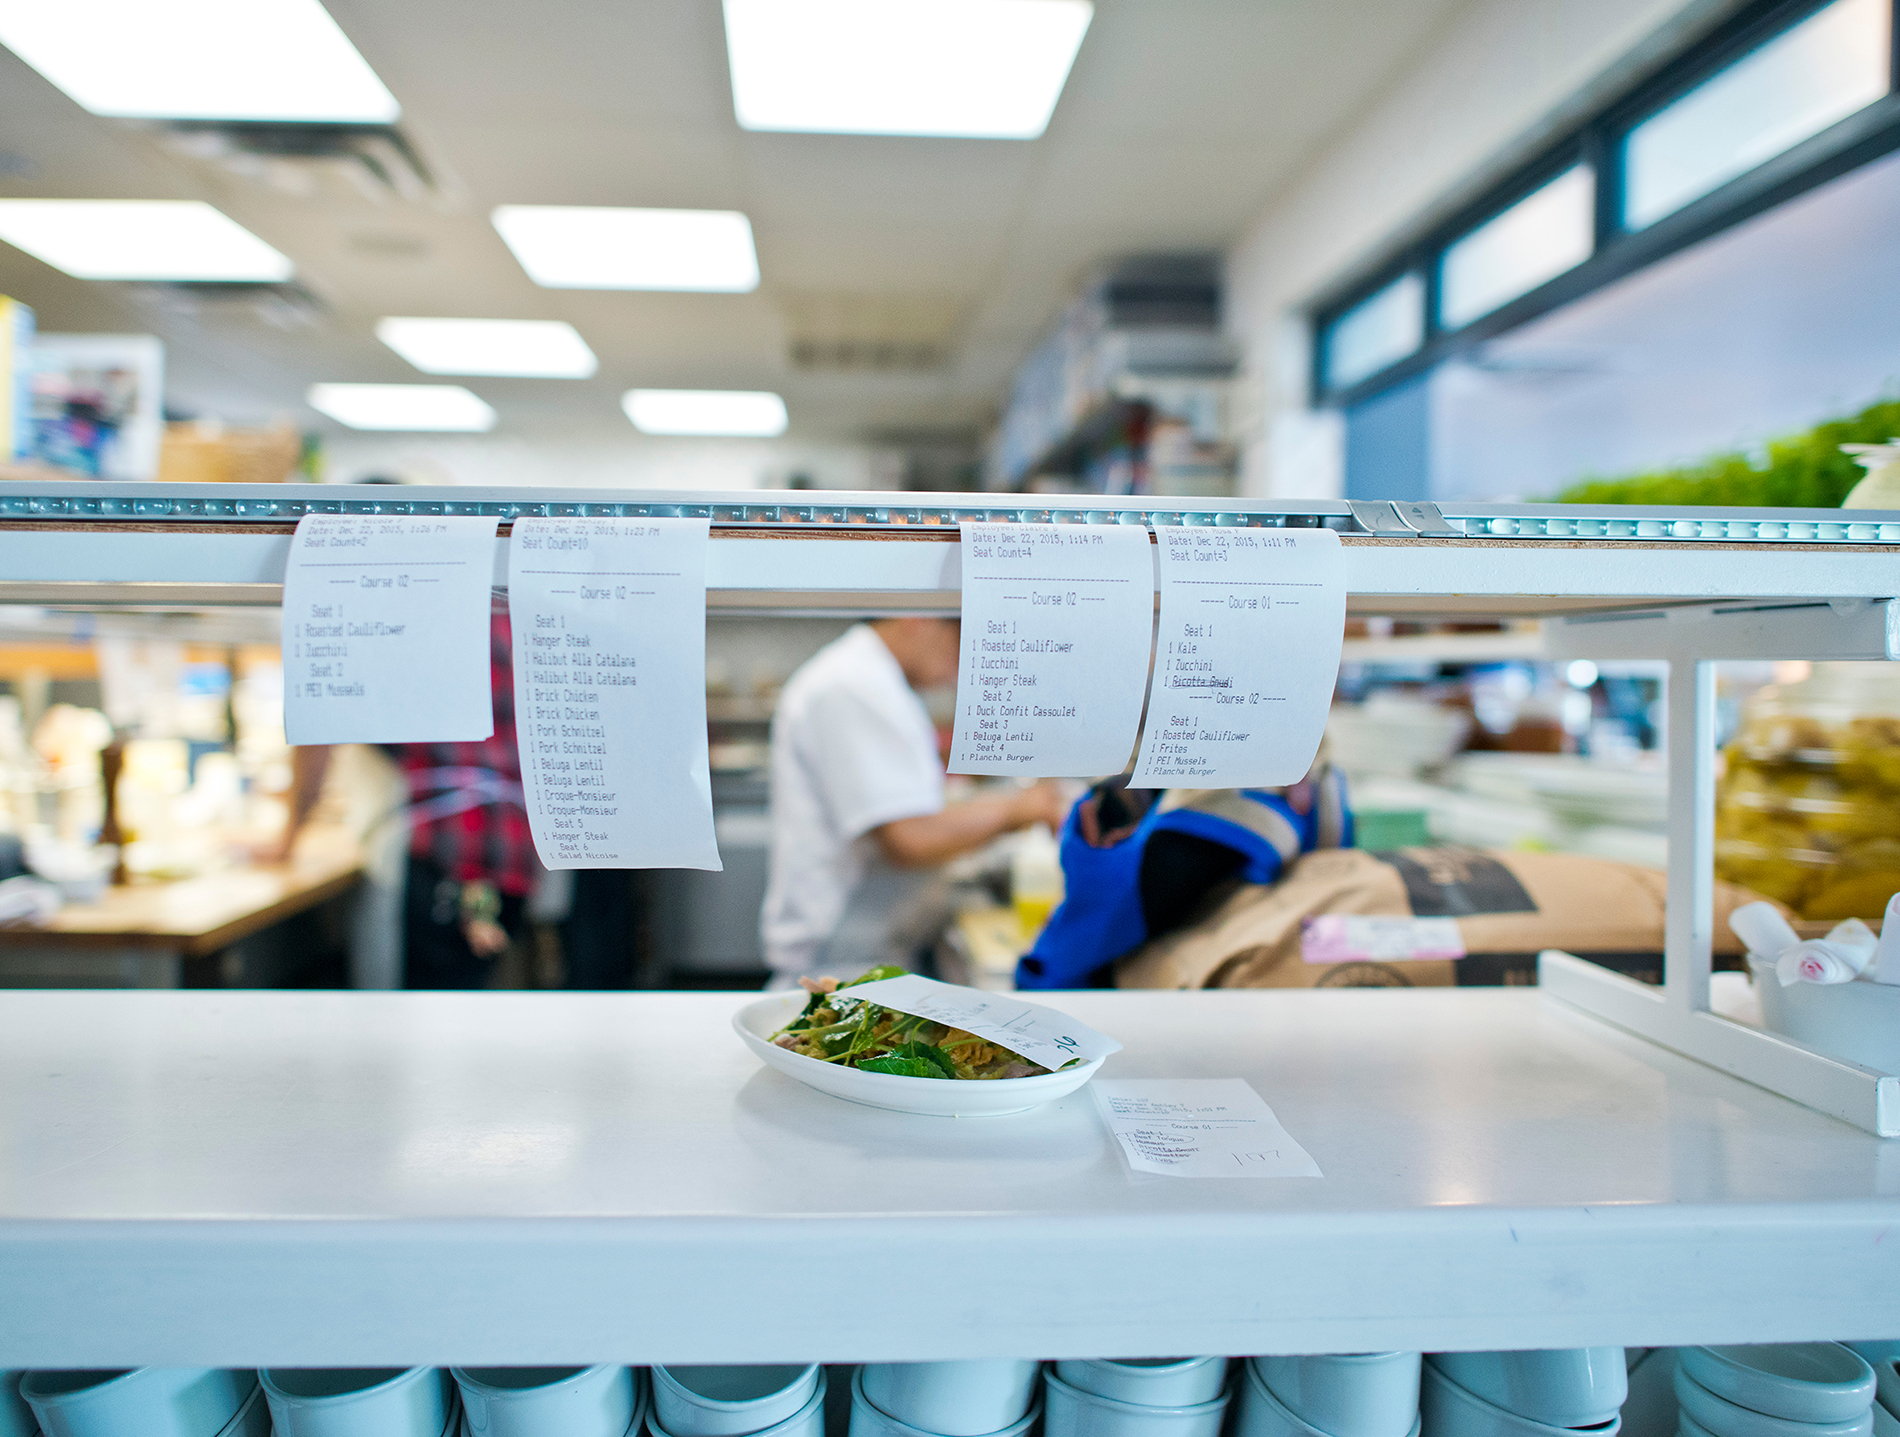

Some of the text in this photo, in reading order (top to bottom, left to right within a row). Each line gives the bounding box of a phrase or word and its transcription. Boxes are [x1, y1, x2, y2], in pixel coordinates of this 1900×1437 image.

[308, 526, 333, 535] Date:
[339, 526, 354, 534] Dec
[359, 526, 374, 534] 22,
[380, 525, 404, 534] 2015,
[435, 525, 447, 533] PM
[524, 525, 549, 534] Date:
[554, 525, 569, 534] Dec
[575, 526, 589, 535] 22,
[595, 527, 619, 537] 2015,
[649, 527, 660, 536] PM
[304, 537, 367, 547] Seat Count=2
[522, 537, 588, 550] Seat Count=10
[973, 533, 1103, 546] Date: Dec 22, 2015, 1:14 PM
[1169, 536, 1296, 549] Date: Dec 22, 2015, 1:11 PM
[973, 547, 1032, 558] Seat Count=4
[1171, 550, 1228, 562] Seat Count=3
[360, 575, 409, 588] Course 02
[580, 585, 626, 599] Course 02
[1032, 591, 1077, 606] Course 02
[1229, 595, 1271, 609] Course 01
[311, 604, 333, 618] Seat
[535, 614, 556, 628] Seat
[987, 621, 1016, 634] Seat 1
[305, 622, 406, 637] Roasted Cauliflower
[1184, 624, 1213, 637] Seat 1
[532, 634, 561, 650] Hanger
[566, 634, 591, 647] Steak
[972, 639, 1074, 653] 1 Roasted Cauliflower
[1169, 642, 1197, 654] 1 Kale
[305, 643, 348, 658] Zucchini
[533, 652, 567, 666] Halibut
[572, 653, 591, 666] Alla
[596, 653, 636, 667] Catalana
[972, 657, 1019, 669] 1 Zucchini
[1166, 659, 1213, 671] 1 Zucchini
[310, 663, 333, 677] Seat
[534, 670, 568, 684] Halibut
[573, 671, 592, 684] Alla
[597, 672, 637, 685] Catalana
[970, 674, 1037, 688] 1 Hanger Steak
[327, 682, 365, 696] Mussels
[983, 690, 1012, 701] Seat 2
[535, 689, 559, 702] Brick
[564, 690, 599, 703] Chicken
[1216, 693, 1259, 704] Course 02
[536, 707, 560, 719] Brick
[565, 708, 599, 720] Chicken
[967, 705, 1076, 717] 1 Duck Confit Cassoulet
[979, 720, 1008, 729] Seat 3
[1170, 716, 1198, 726] Seat 1
[537, 724, 557, 736] Pork
[562, 725, 605, 738] Schnitzel
[964, 732, 1034, 743] 1 Beluga Lentil
[1154, 730, 1250, 741] 1 Roasted Cauliflower
[539, 741, 559, 754] Pork
[563, 742, 606, 754] Schnitzel
[1151, 744, 1188, 753] 1 Frites
[1007, 754, 1034, 762] Burger
[1174, 757, 1207, 765] Mussels
[541, 758, 570, 772] Beluga
[574, 759, 603, 771] Lentil
[1189, 768, 1216, 776] Burger
[543, 774, 572, 788] Beluga
[576, 775, 605, 786] Lentil
[545, 789, 616, 802] Croque-Monsieur
[547, 804, 618, 817] Croque-Monsieur
[554, 819, 583, 829] Seat 5
[552, 832, 581, 842] Hanger
[585, 832, 609, 840] Steak
[560, 843, 579, 851] Seat
